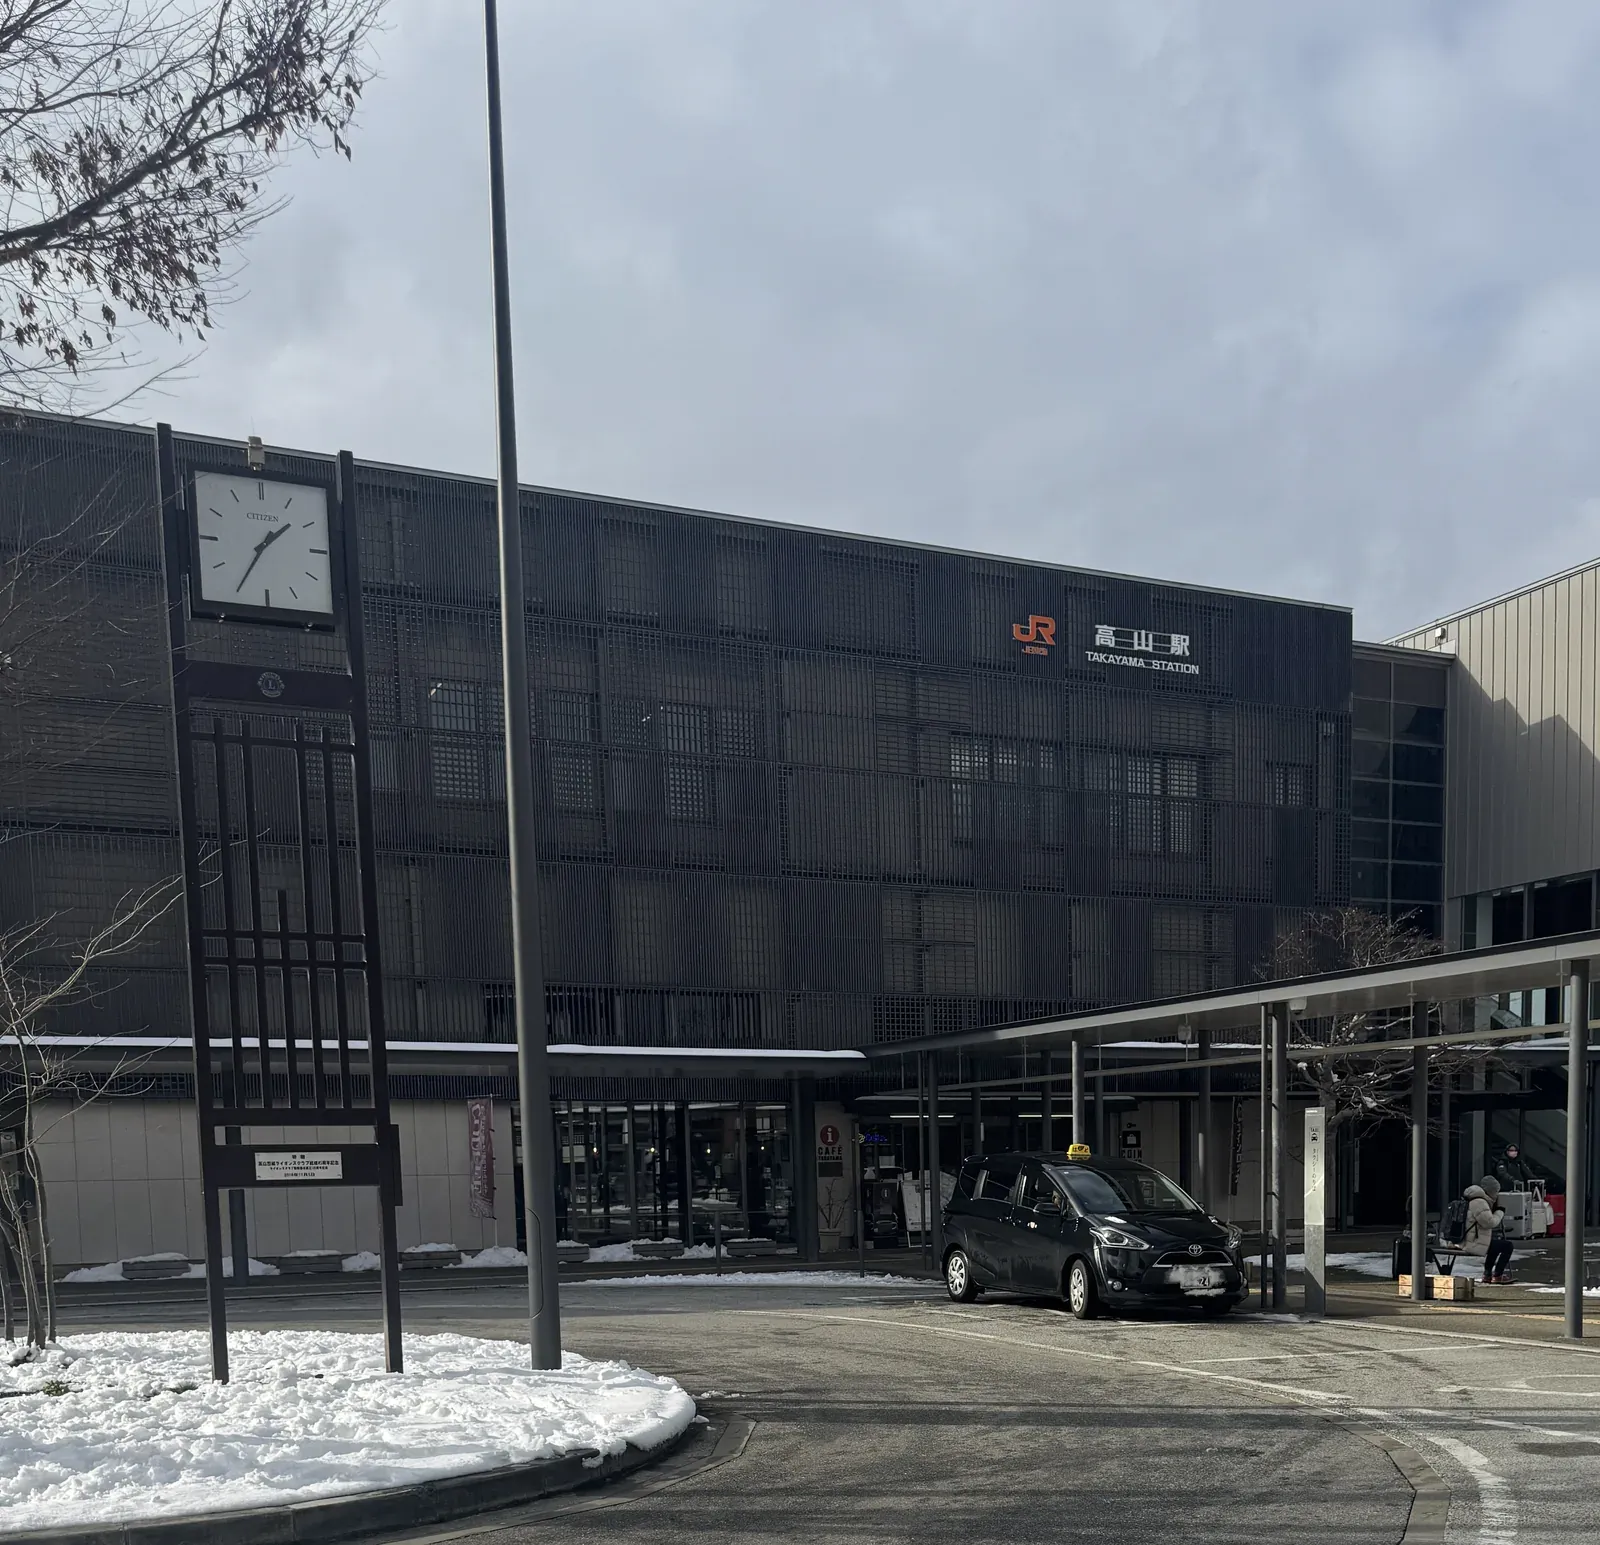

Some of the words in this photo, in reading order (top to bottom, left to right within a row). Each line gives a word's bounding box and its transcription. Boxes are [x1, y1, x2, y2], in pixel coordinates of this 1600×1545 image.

[246, 512, 279, 523] CITIZEN
[1013, 614, 1056, 646] JR
[1095, 624, 1190, 657] 高山駅
[1085, 650, 1145, 668] TAKAYAMA
[1152, 660, 1200, 675] STATION
[1121, 1149, 1143, 1158] COIN
